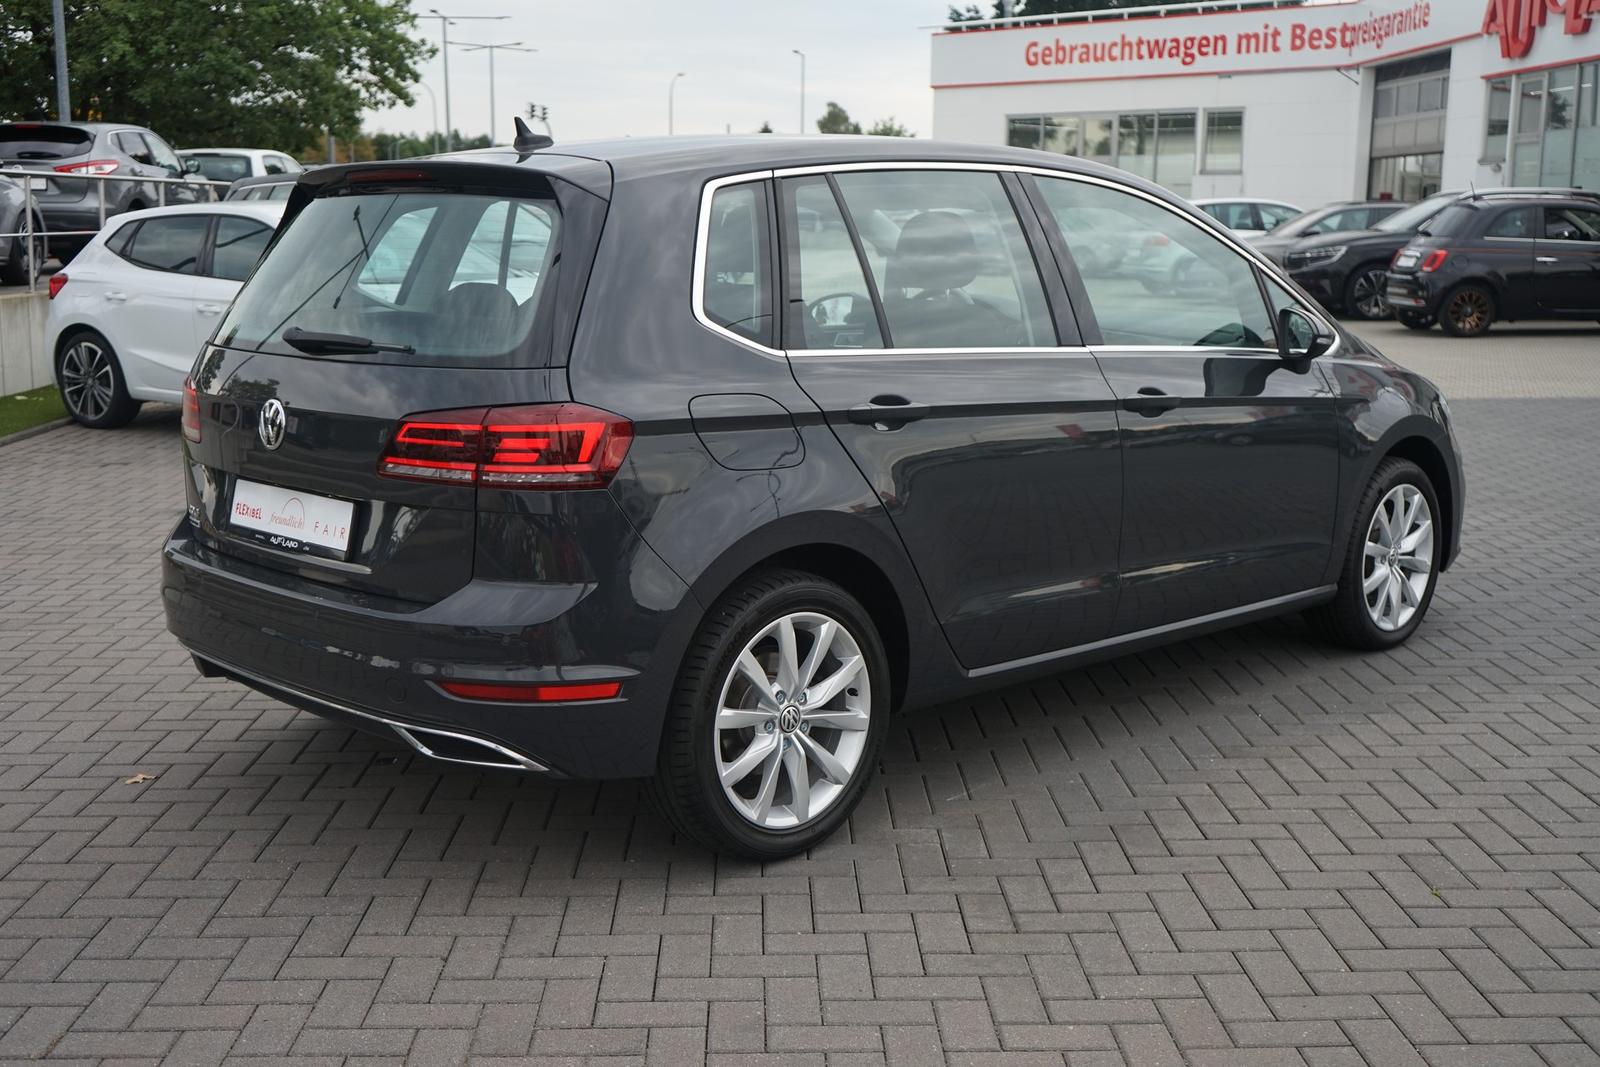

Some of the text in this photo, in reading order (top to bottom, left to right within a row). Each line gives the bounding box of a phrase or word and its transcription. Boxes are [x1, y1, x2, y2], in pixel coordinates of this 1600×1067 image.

[1024, 0, 1431, 66] Gebrauchtwagen mit Bestpreisgarantie
[235, 502, 262, 520] FLEXIBEL
